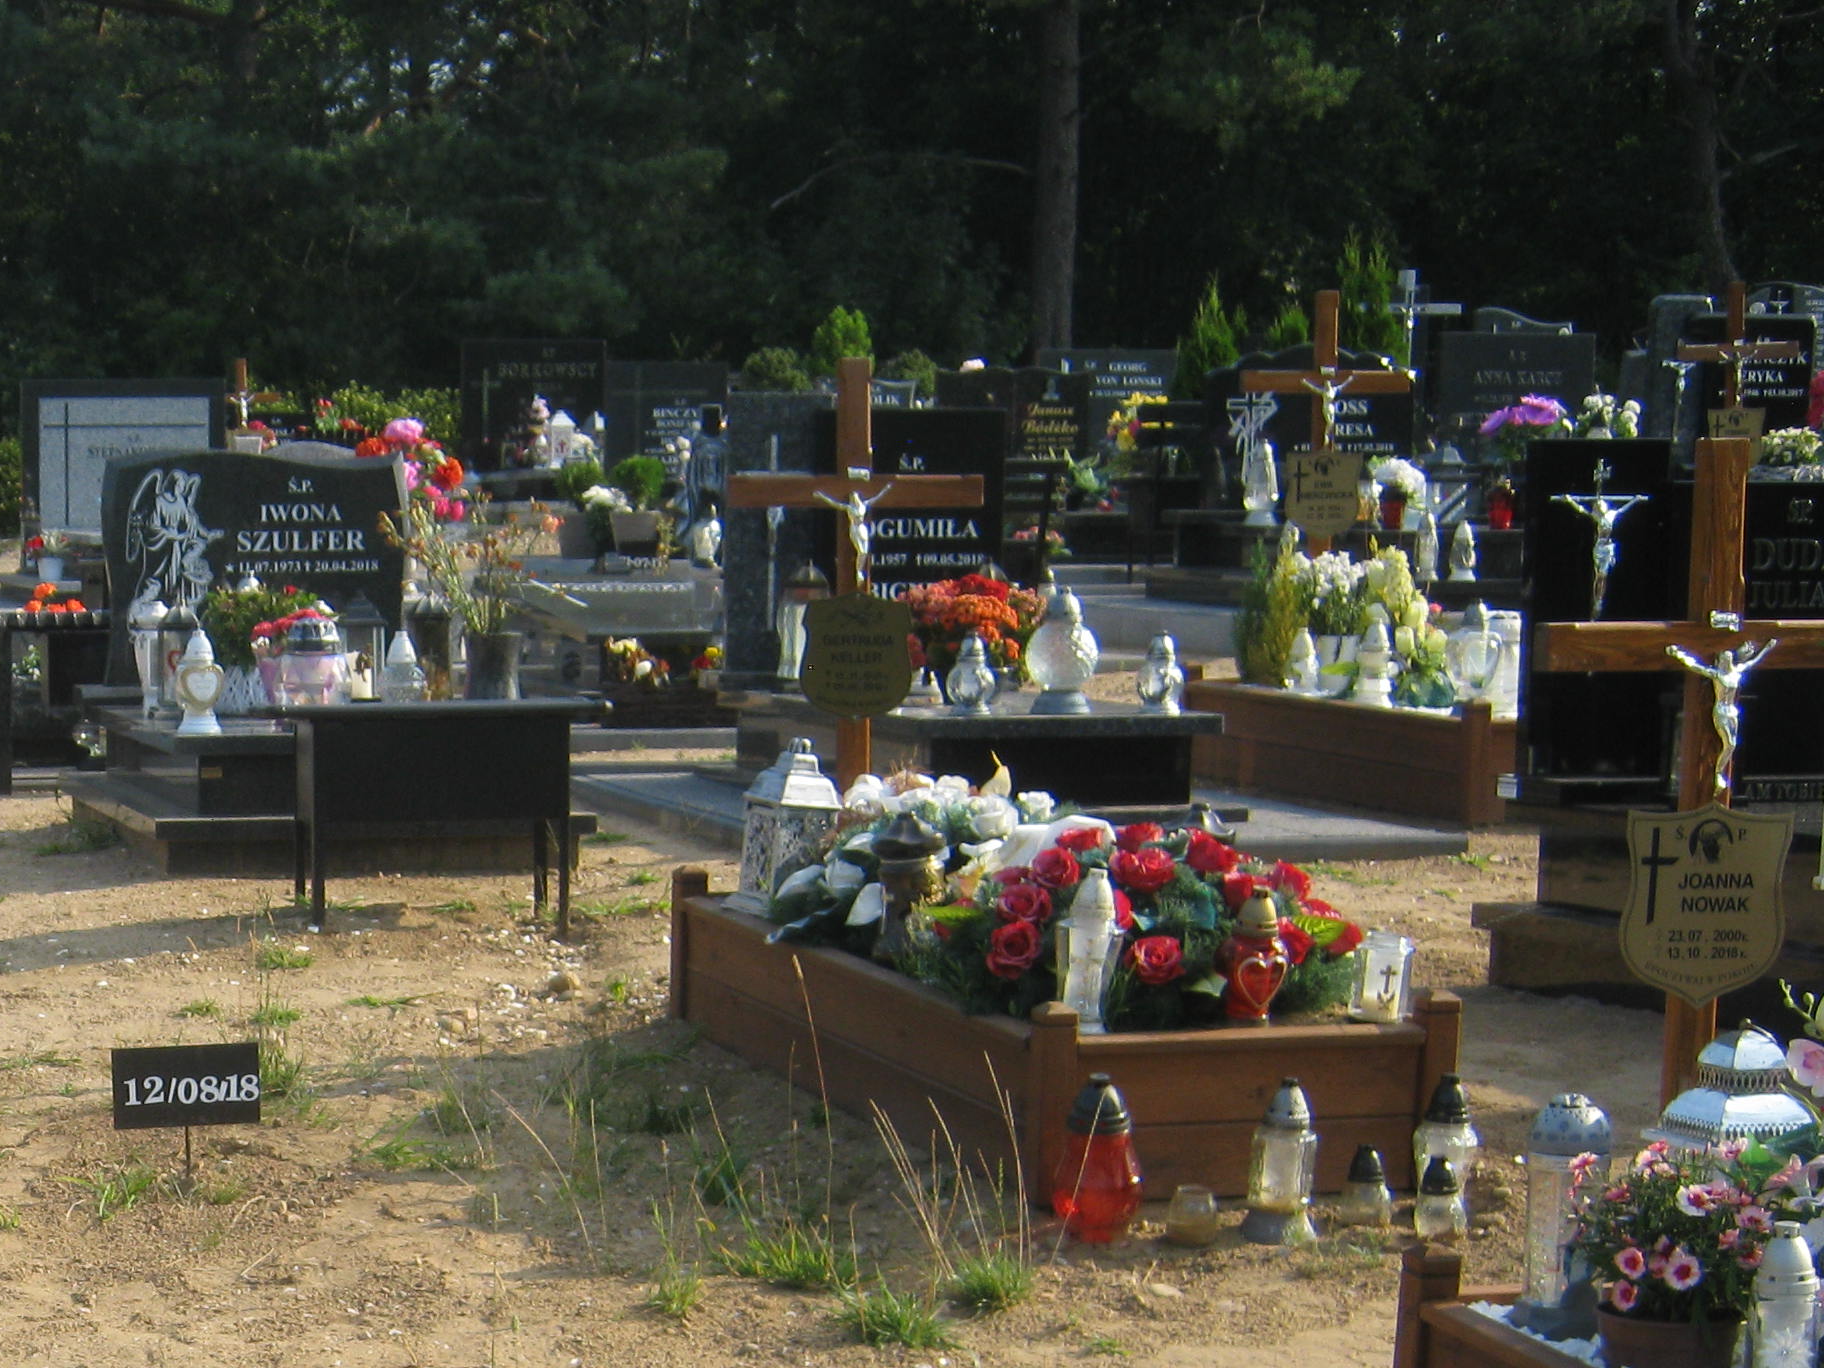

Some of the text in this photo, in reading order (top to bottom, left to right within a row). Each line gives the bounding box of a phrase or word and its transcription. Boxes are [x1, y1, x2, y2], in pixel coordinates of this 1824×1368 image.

[1474, 370, 1512, 385] ANNA
[1334, 399, 1368, 415] OSS
[1334, 422, 1374, 436] RESA
[287, 475, 315, 493] Ś.P.
[259, 503, 343, 522] IWONA
[236, 529, 366, 552] SZULFER
[1752, 537, 1824, 571] DUD
[1678, 873, 1754, 889] JOANNA
[1680, 896, 1749, 913] NOWAK
[123, 1074, 260, 1106] 12/08/18
